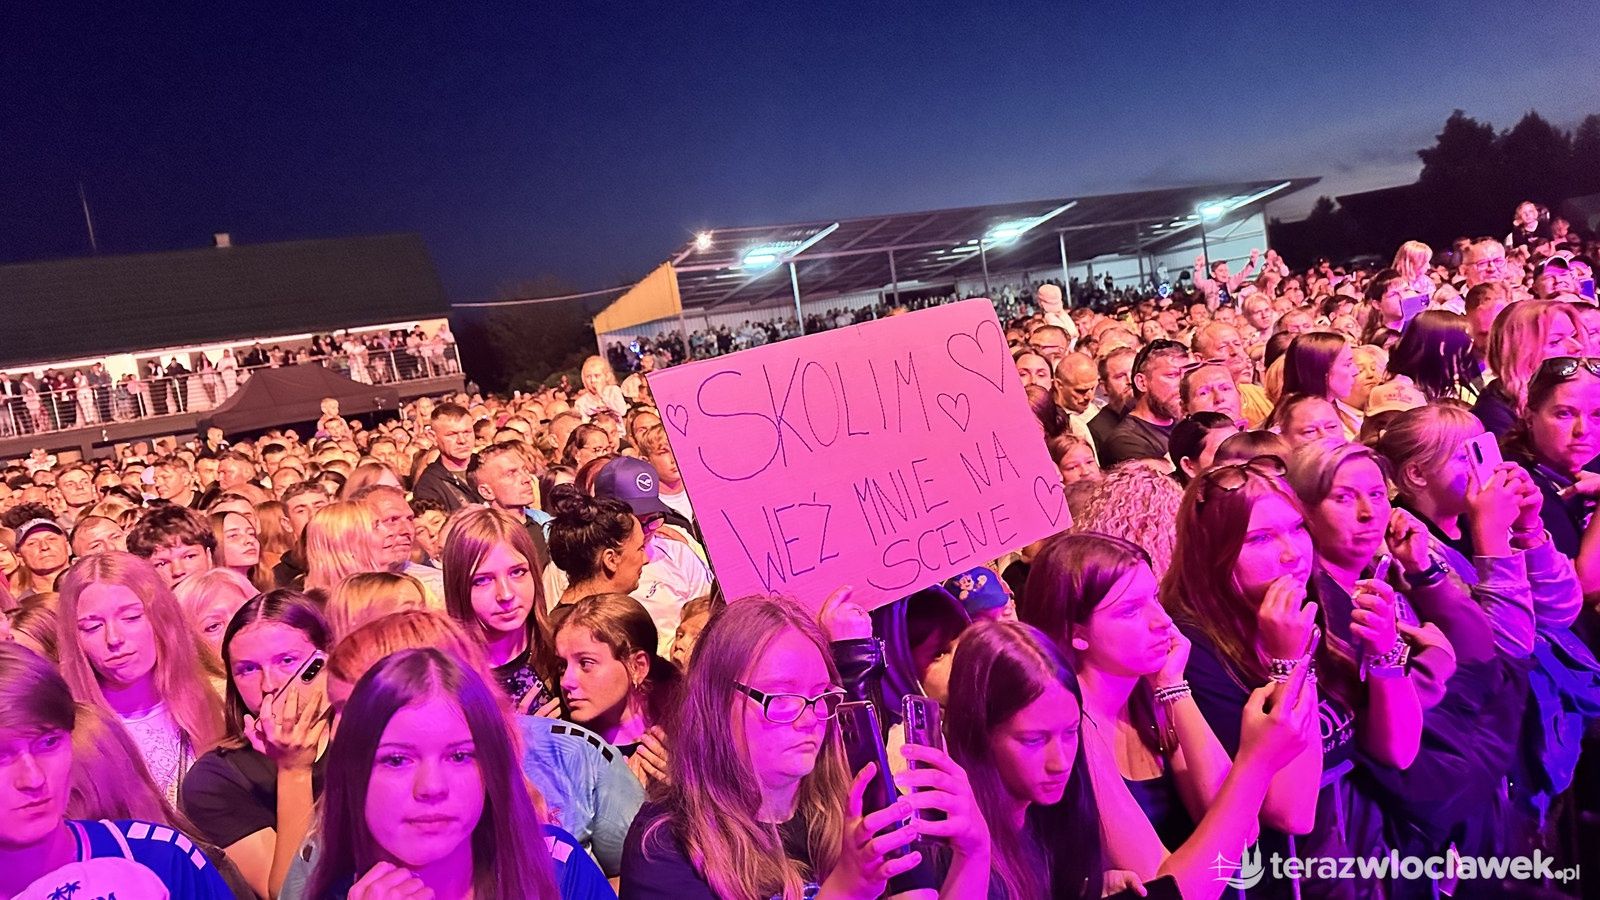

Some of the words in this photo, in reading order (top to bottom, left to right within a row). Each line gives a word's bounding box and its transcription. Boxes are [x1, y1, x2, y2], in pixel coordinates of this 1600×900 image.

[697, 352, 932, 482] SKOLIM
[853, 458, 949, 546] MNIE
[960, 431, 1021, 495] NA
[867, 503, 1018, 591] SCENE
